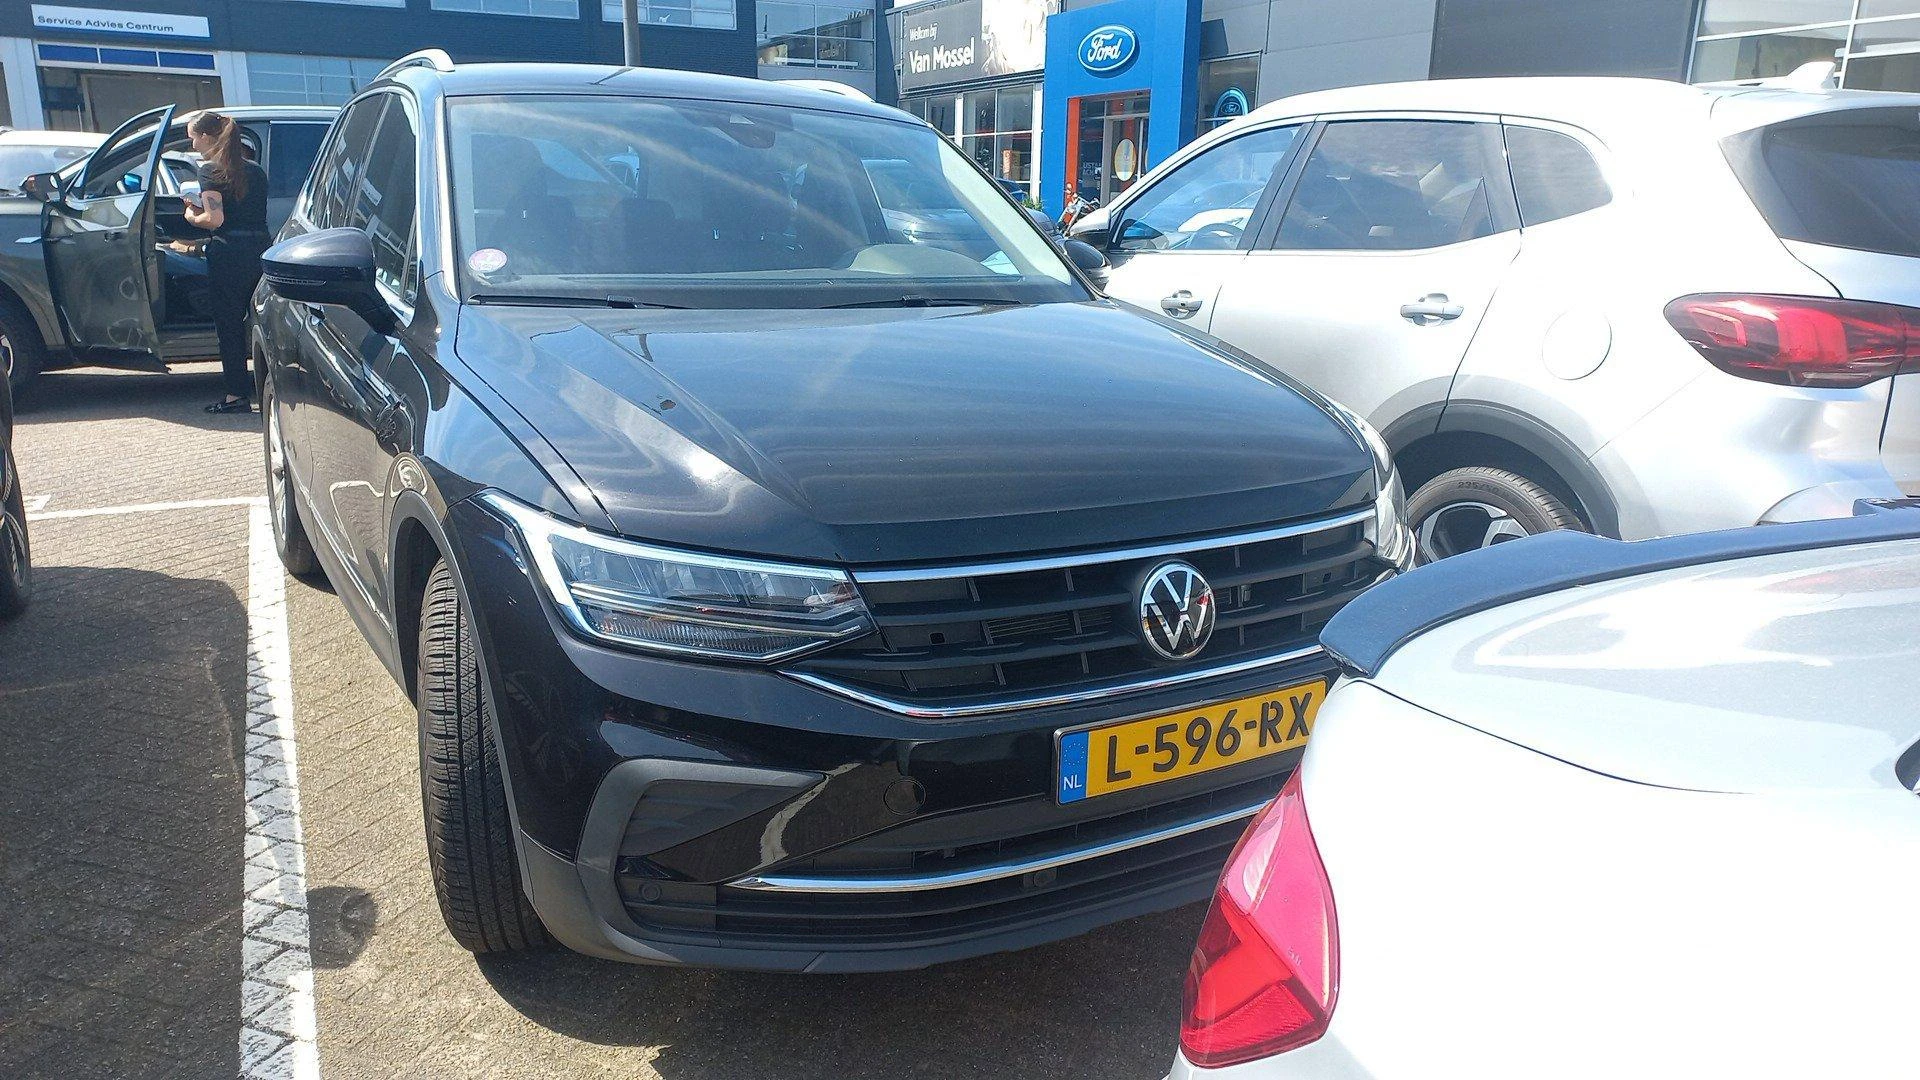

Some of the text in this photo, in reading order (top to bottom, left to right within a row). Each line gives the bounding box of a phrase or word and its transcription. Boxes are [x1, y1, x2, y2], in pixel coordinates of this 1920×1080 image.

[37, 15, 174, 33] Service Advies Centrum
[908, 36, 975, 74] Van Mossel
[1087, 32, 1123, 63] Ford
[1106, 691, 1313, 783] L-596-RX
[1063, 774, 1083, 791] NL
